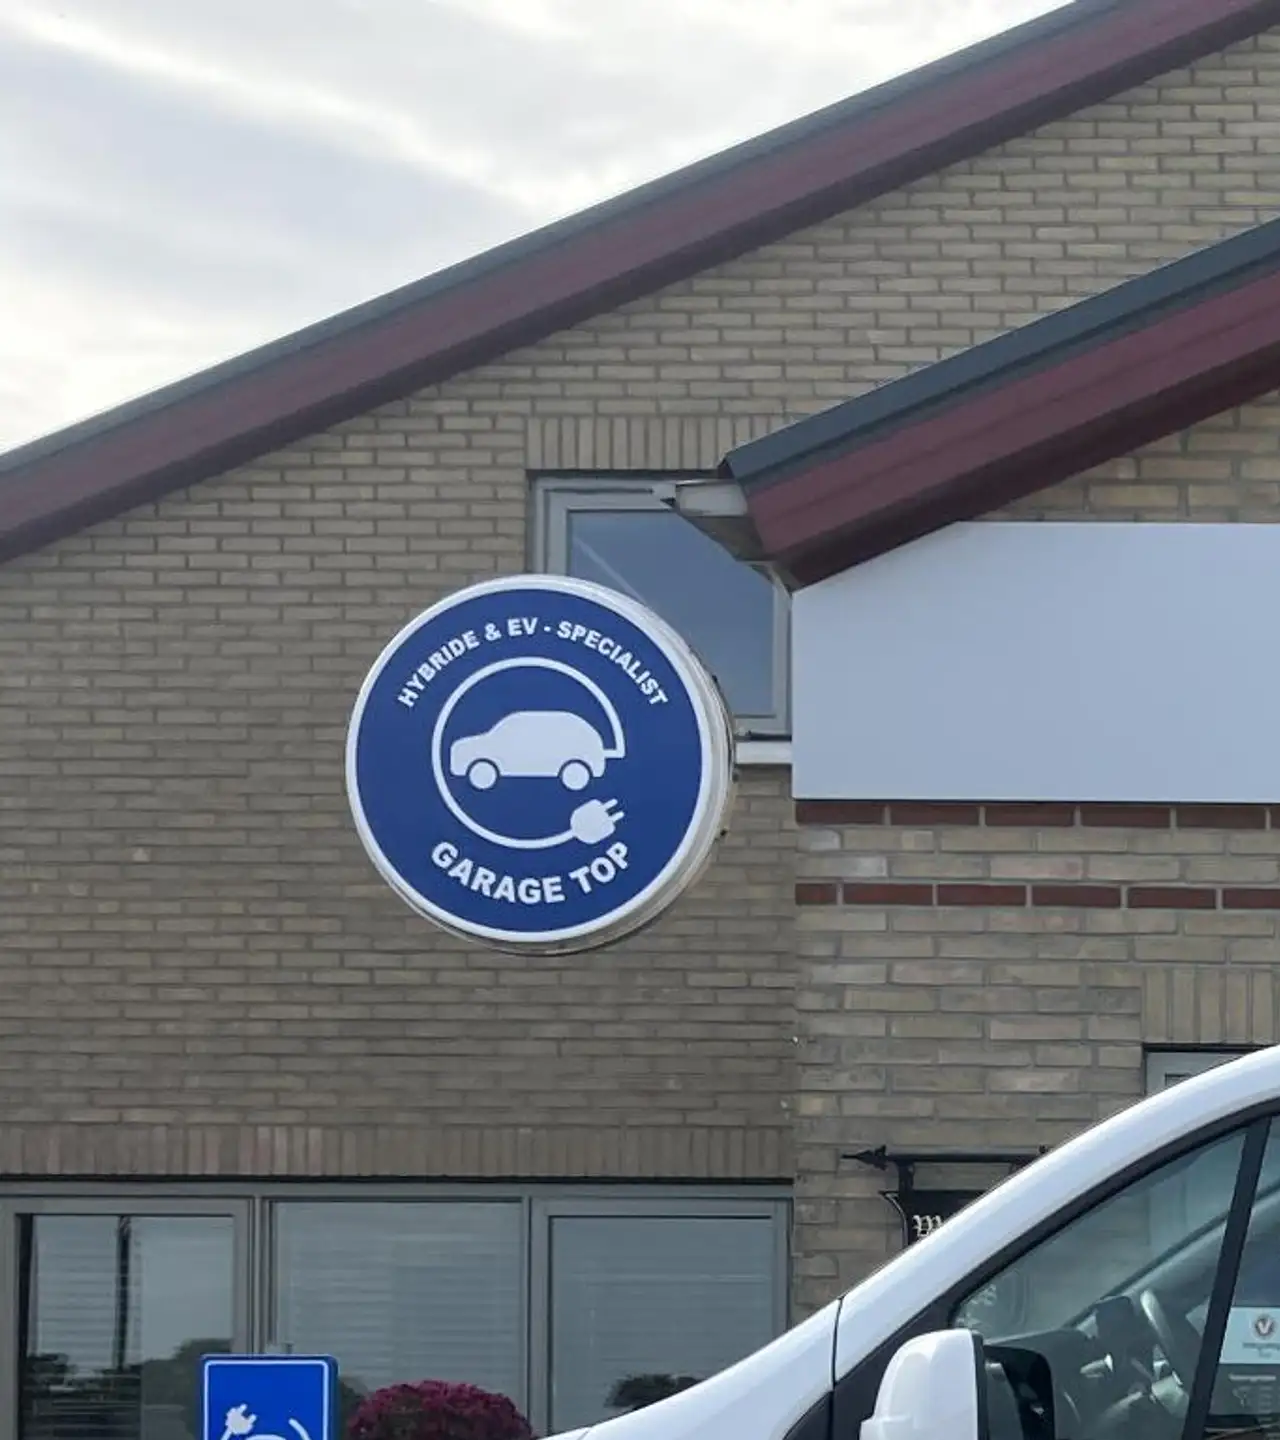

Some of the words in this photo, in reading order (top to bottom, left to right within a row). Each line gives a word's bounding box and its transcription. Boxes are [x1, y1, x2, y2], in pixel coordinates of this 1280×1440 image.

[397, 630, 480, 708] HYBRIDE
[485, 622, 502, 641] &
[507, 616, 539, 637] EV
[556, 620, 668, 707] SPECIALIST
[430, 841, 566, 904] GARAGE
[570, 842, 632, 894] TOP
